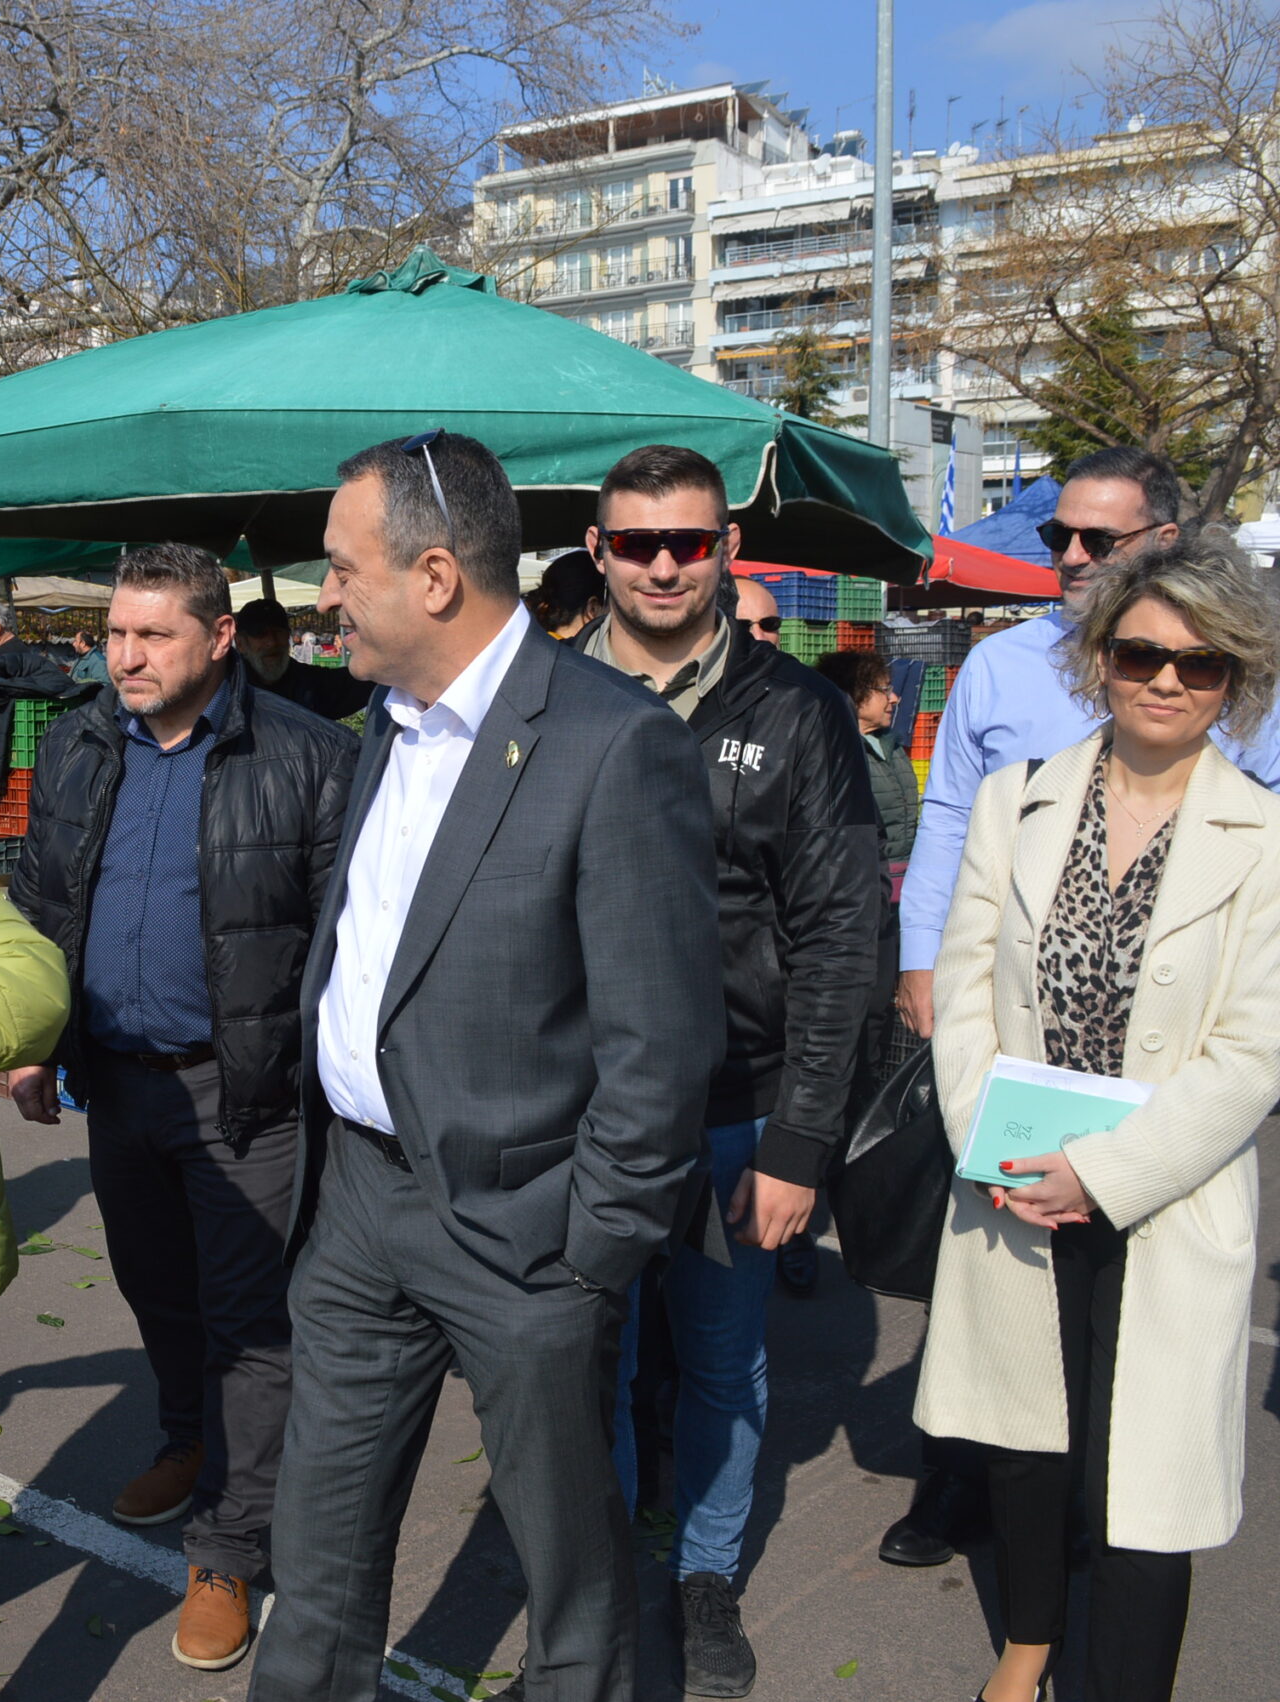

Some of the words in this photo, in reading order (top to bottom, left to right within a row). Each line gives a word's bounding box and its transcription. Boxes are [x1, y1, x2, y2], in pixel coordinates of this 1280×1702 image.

[718, 738, 765, 772] LEONE
[1004, 1121, 1019, 1138] 20
[1021, 1124, 1033, 1141] 24
